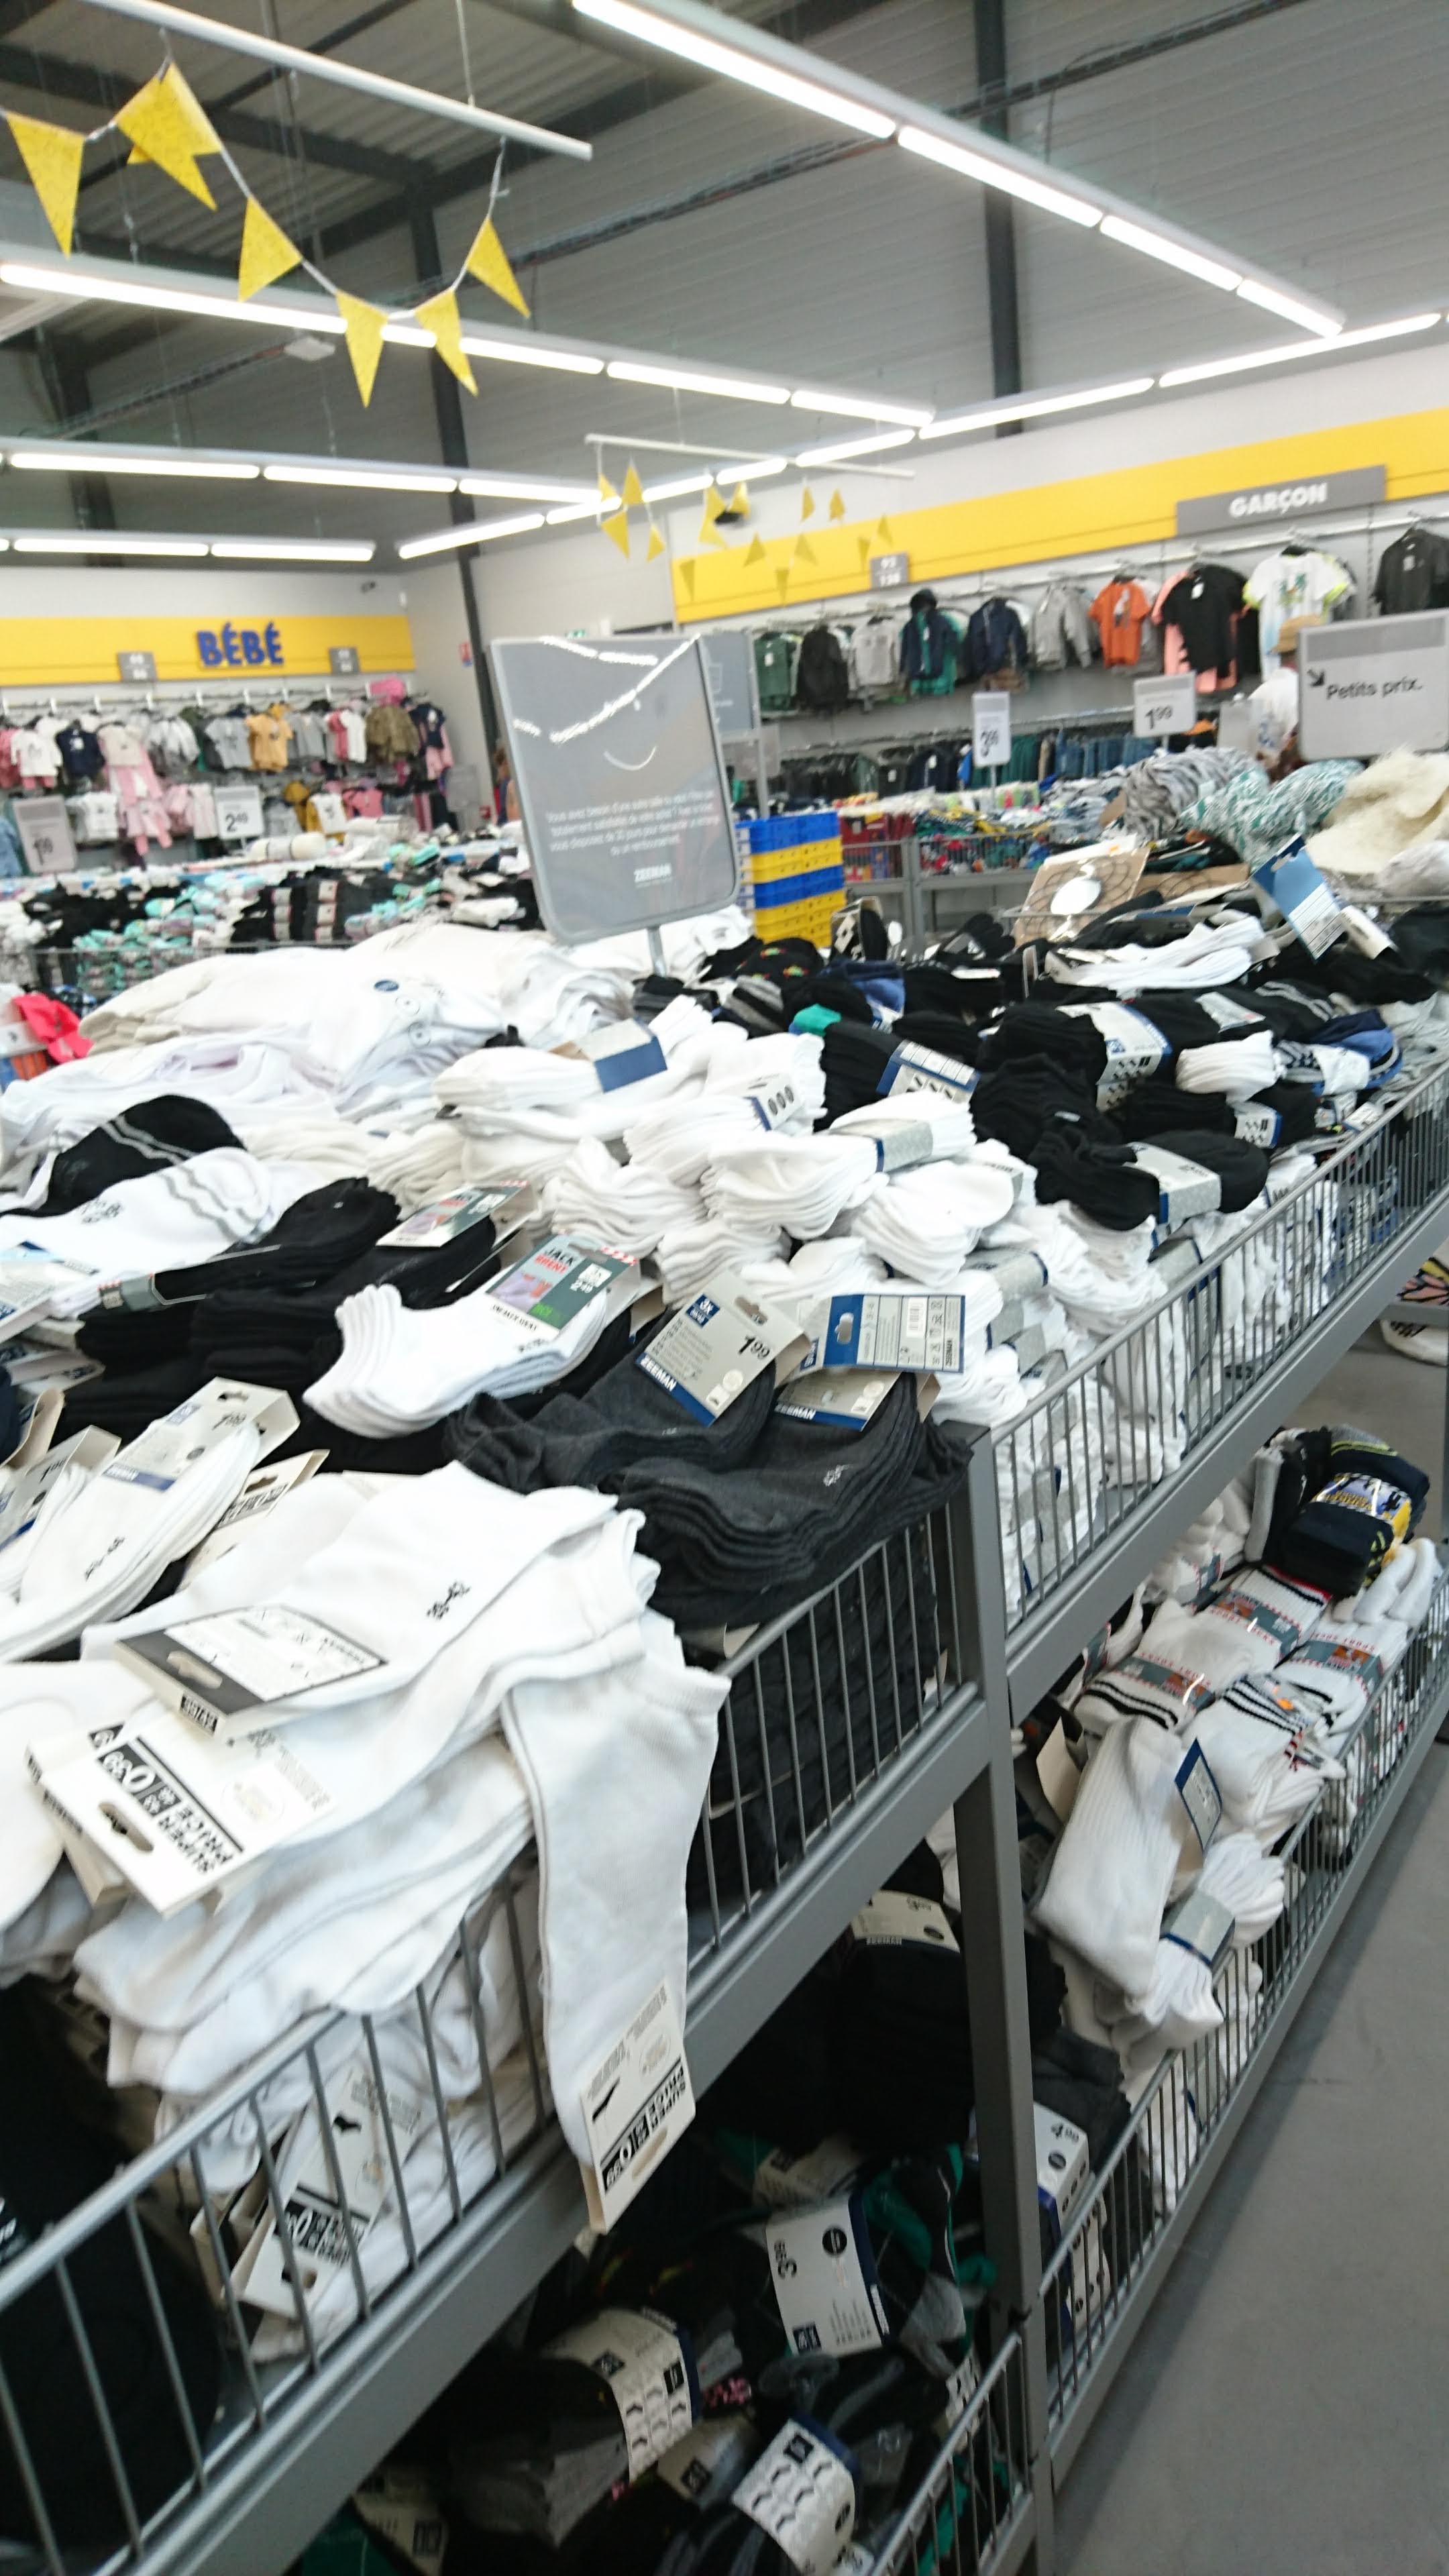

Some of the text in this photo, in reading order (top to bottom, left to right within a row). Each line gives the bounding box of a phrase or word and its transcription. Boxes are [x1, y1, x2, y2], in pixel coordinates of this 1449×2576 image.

[1230, 482, 1328, 518] GARÇON
[197, 621, 284, 666] BÉBÉ
[1326, 676, 1423, 700] Petits prix.
[544, 1248, 574, 1266] JACK
[639, 1355, 678, 1392] ZEEMAN
